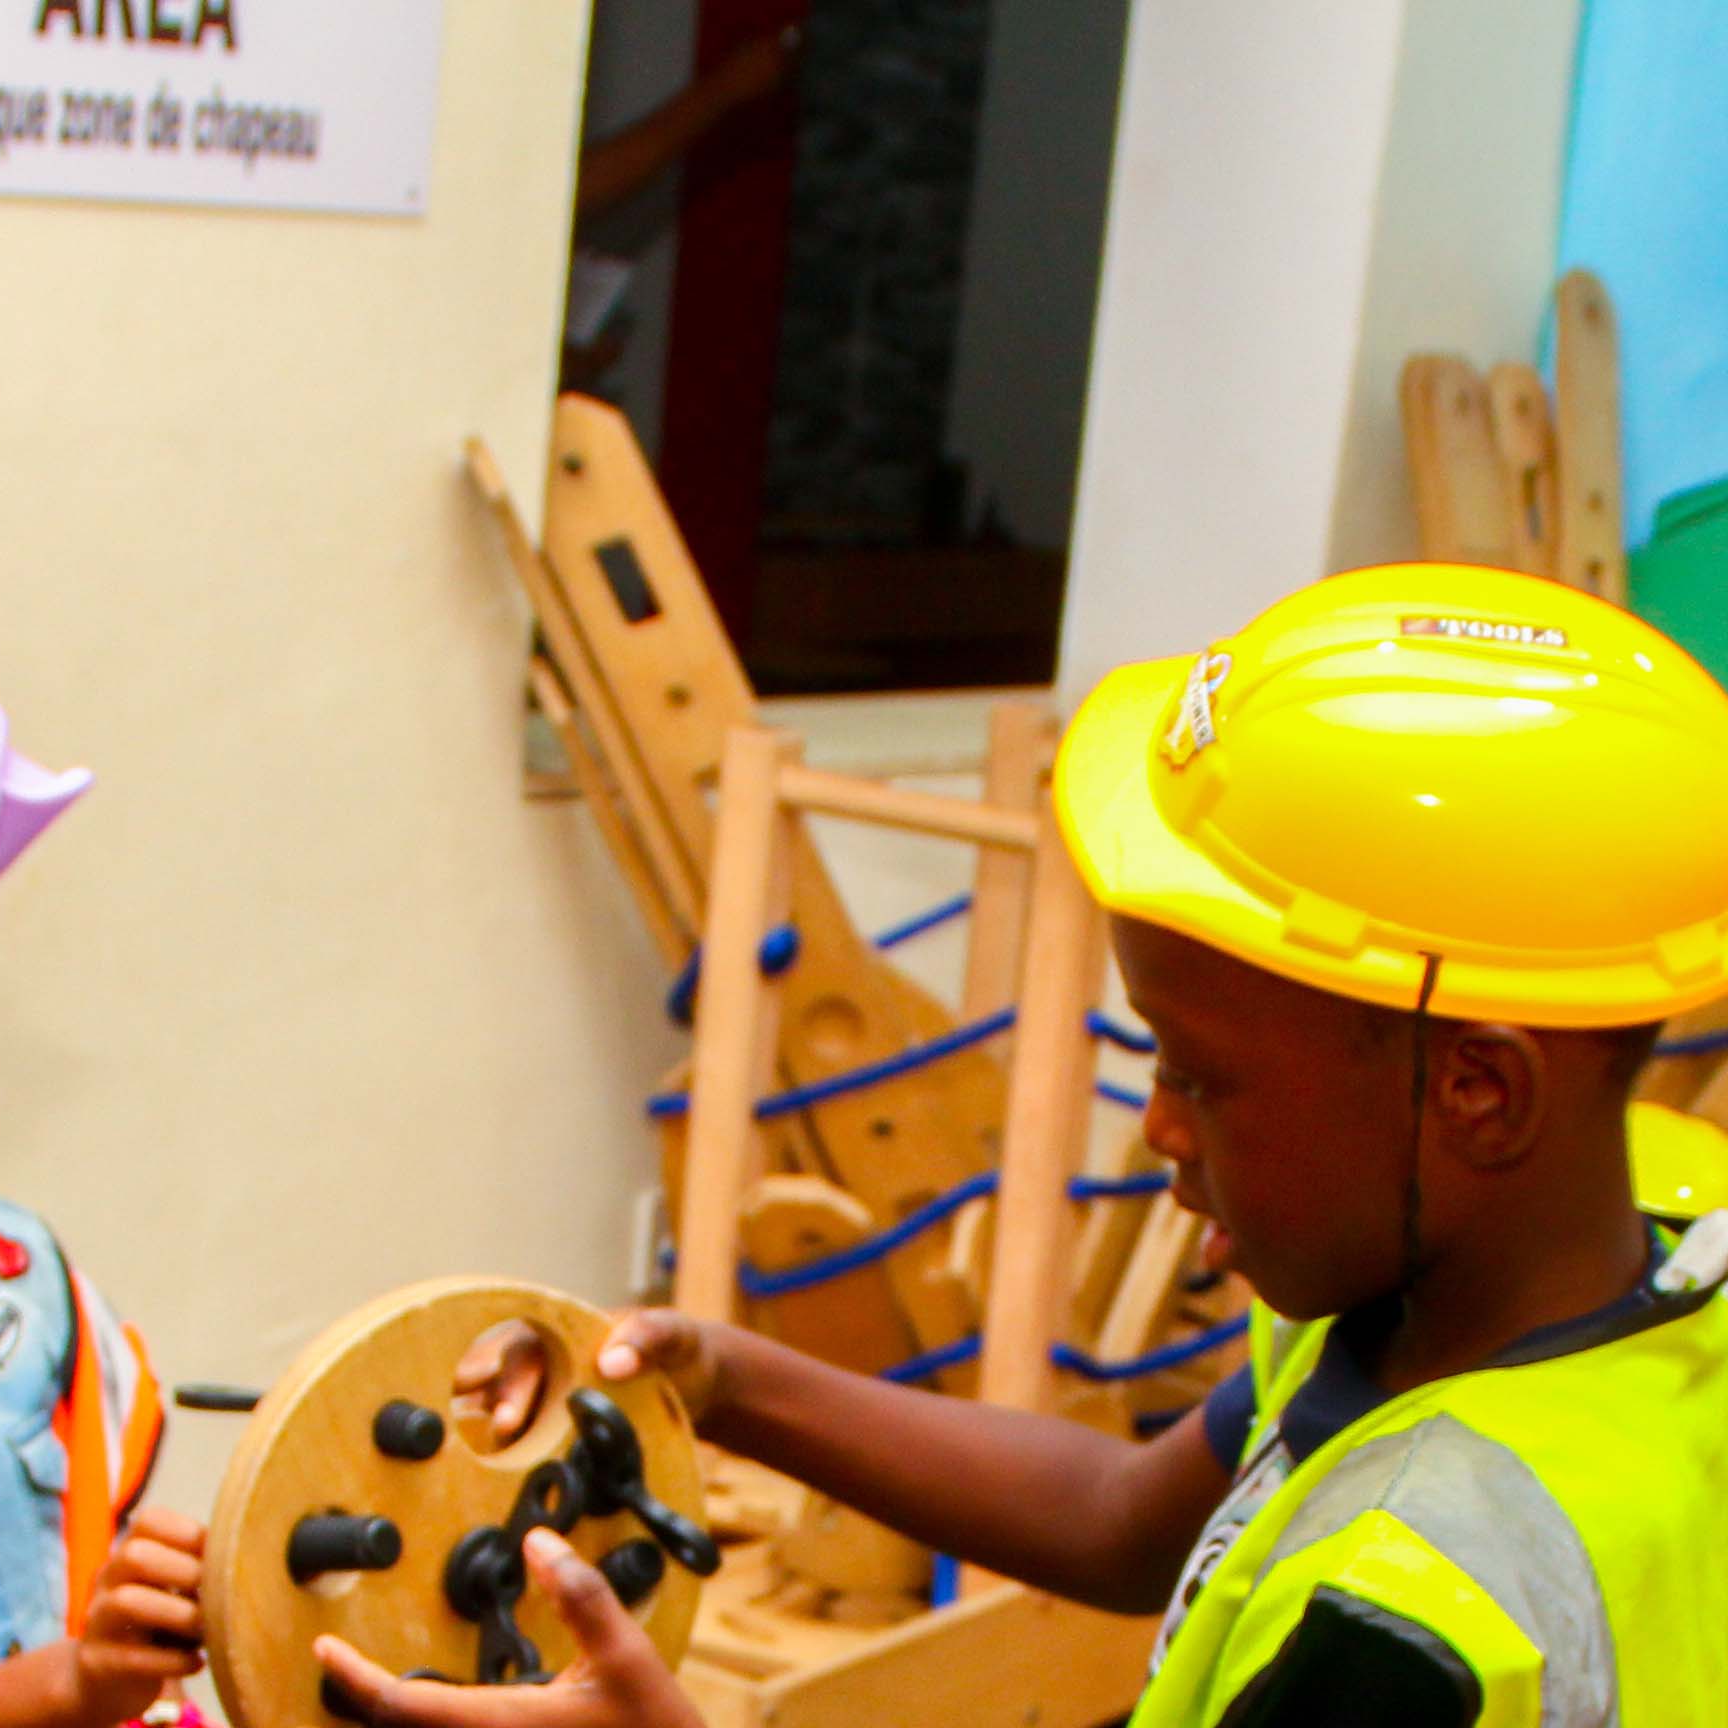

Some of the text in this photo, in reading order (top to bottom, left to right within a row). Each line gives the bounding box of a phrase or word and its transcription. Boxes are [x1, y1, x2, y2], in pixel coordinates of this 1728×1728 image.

[60, 90, 133, 147] zone
[147, 80, 180, 149] de
[195, 83, 318, 173] chapeau
[1440, 618, 1566, 647] TOOLS
